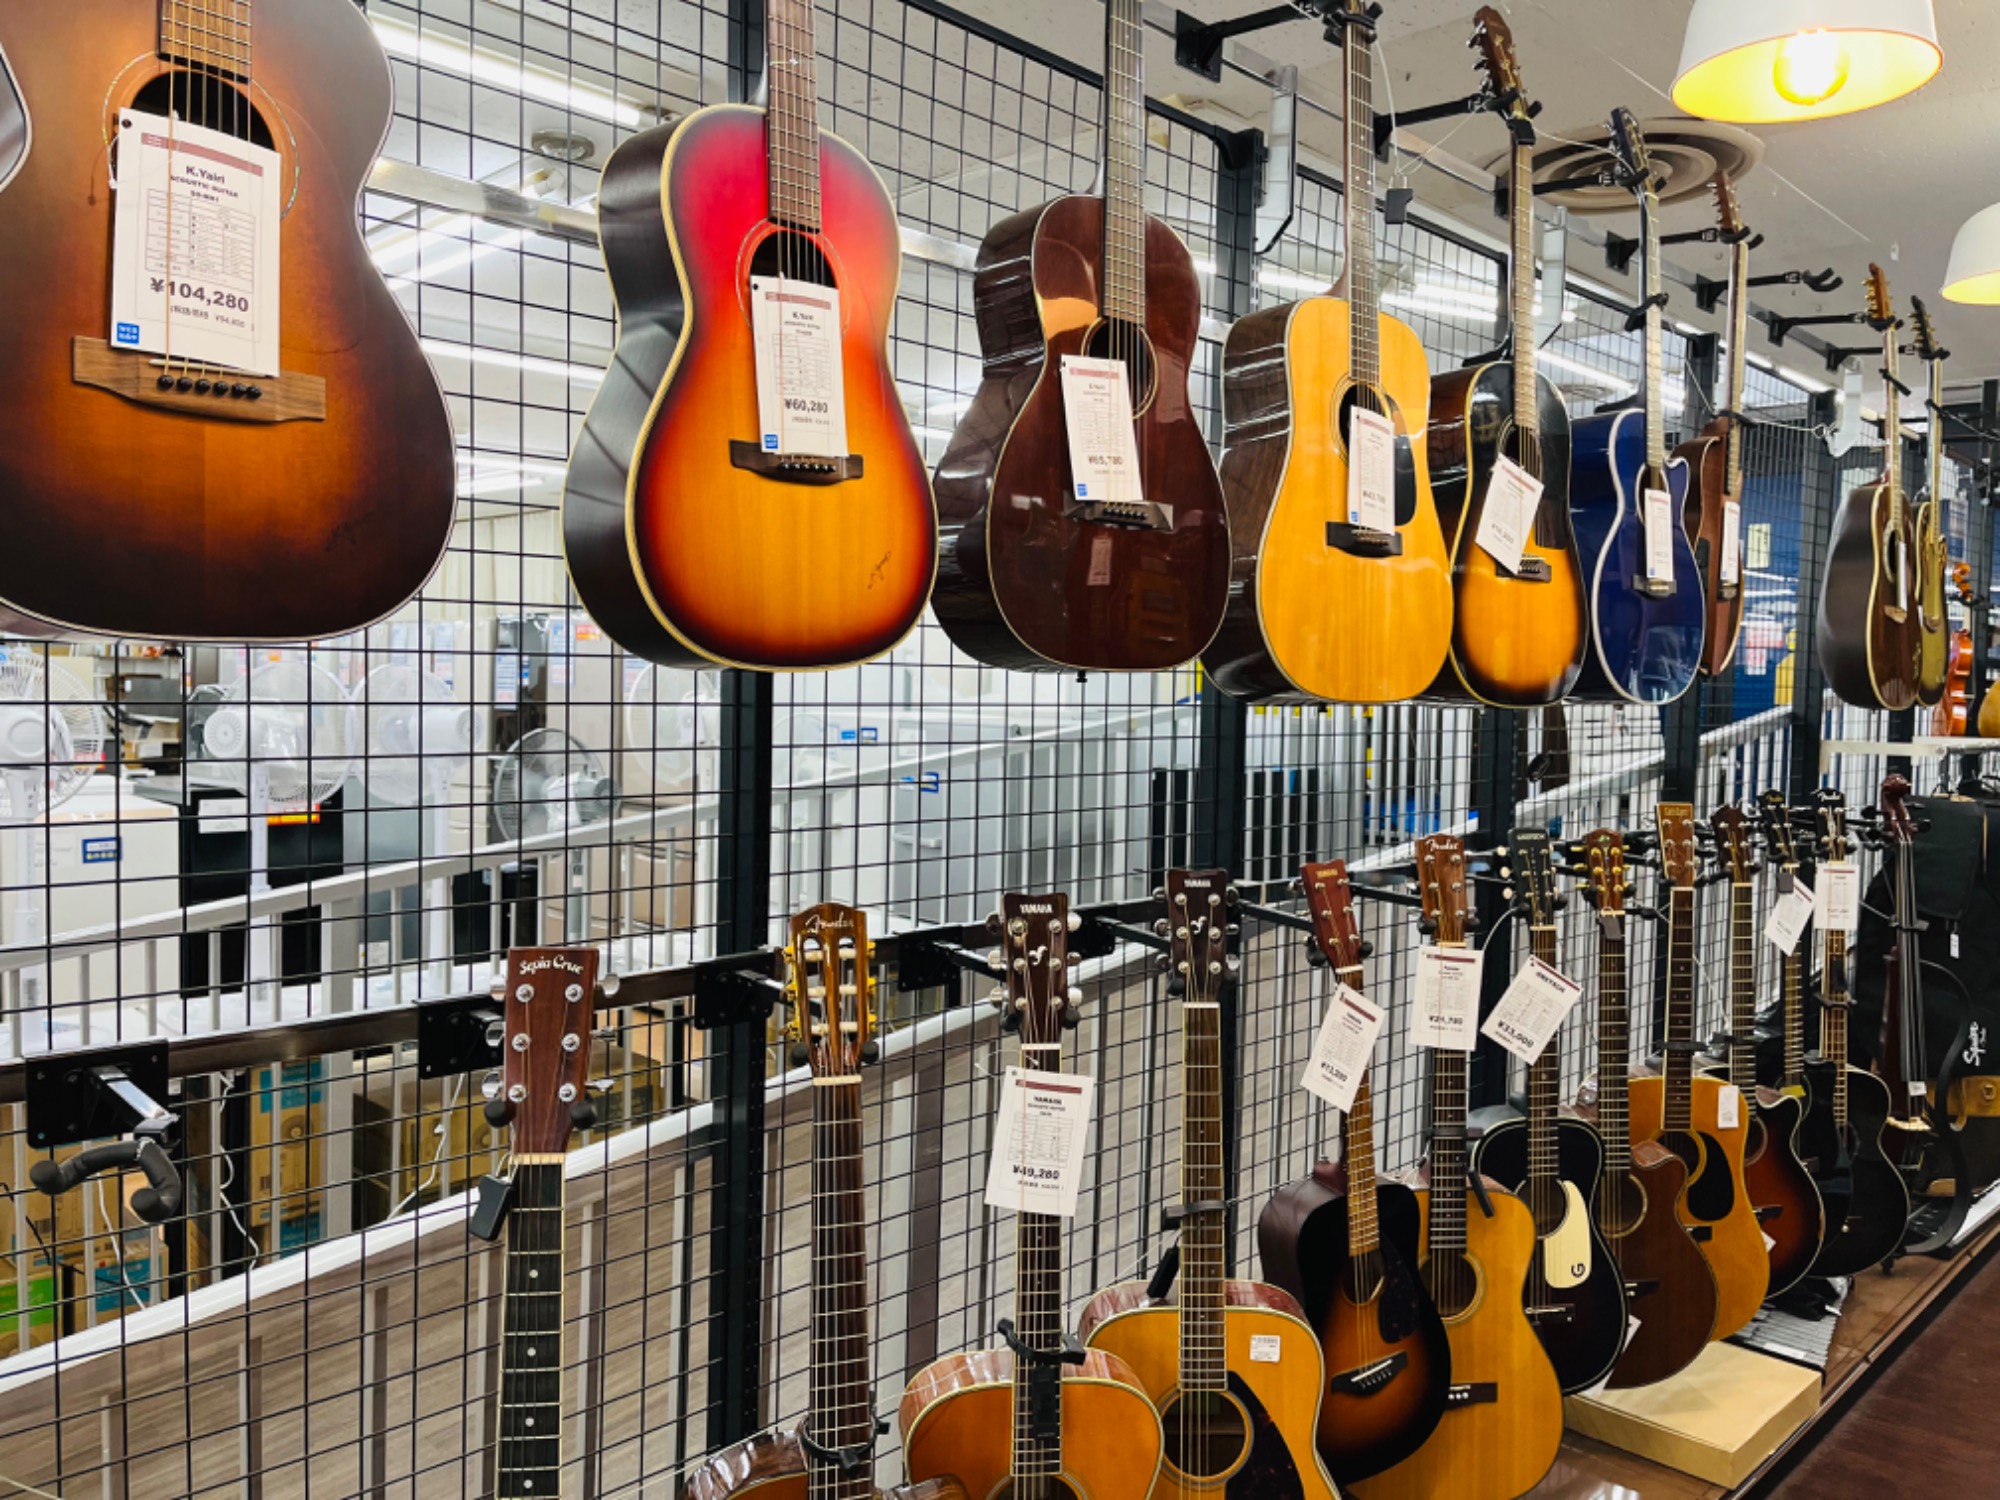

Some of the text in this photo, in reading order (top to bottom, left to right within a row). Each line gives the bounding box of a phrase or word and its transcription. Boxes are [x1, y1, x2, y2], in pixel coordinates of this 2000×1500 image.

[186, 166, 225, 184] K.Yairi
[150, 277, 249, 312] ¥104,280
[784, 398, 828, 413] ¥60,280
[1019, 903, 1053, 914] YAMAHA
[805, 911, 854, 934] Fender
[1013, 1164, 1060, 1180] ¥49,280
